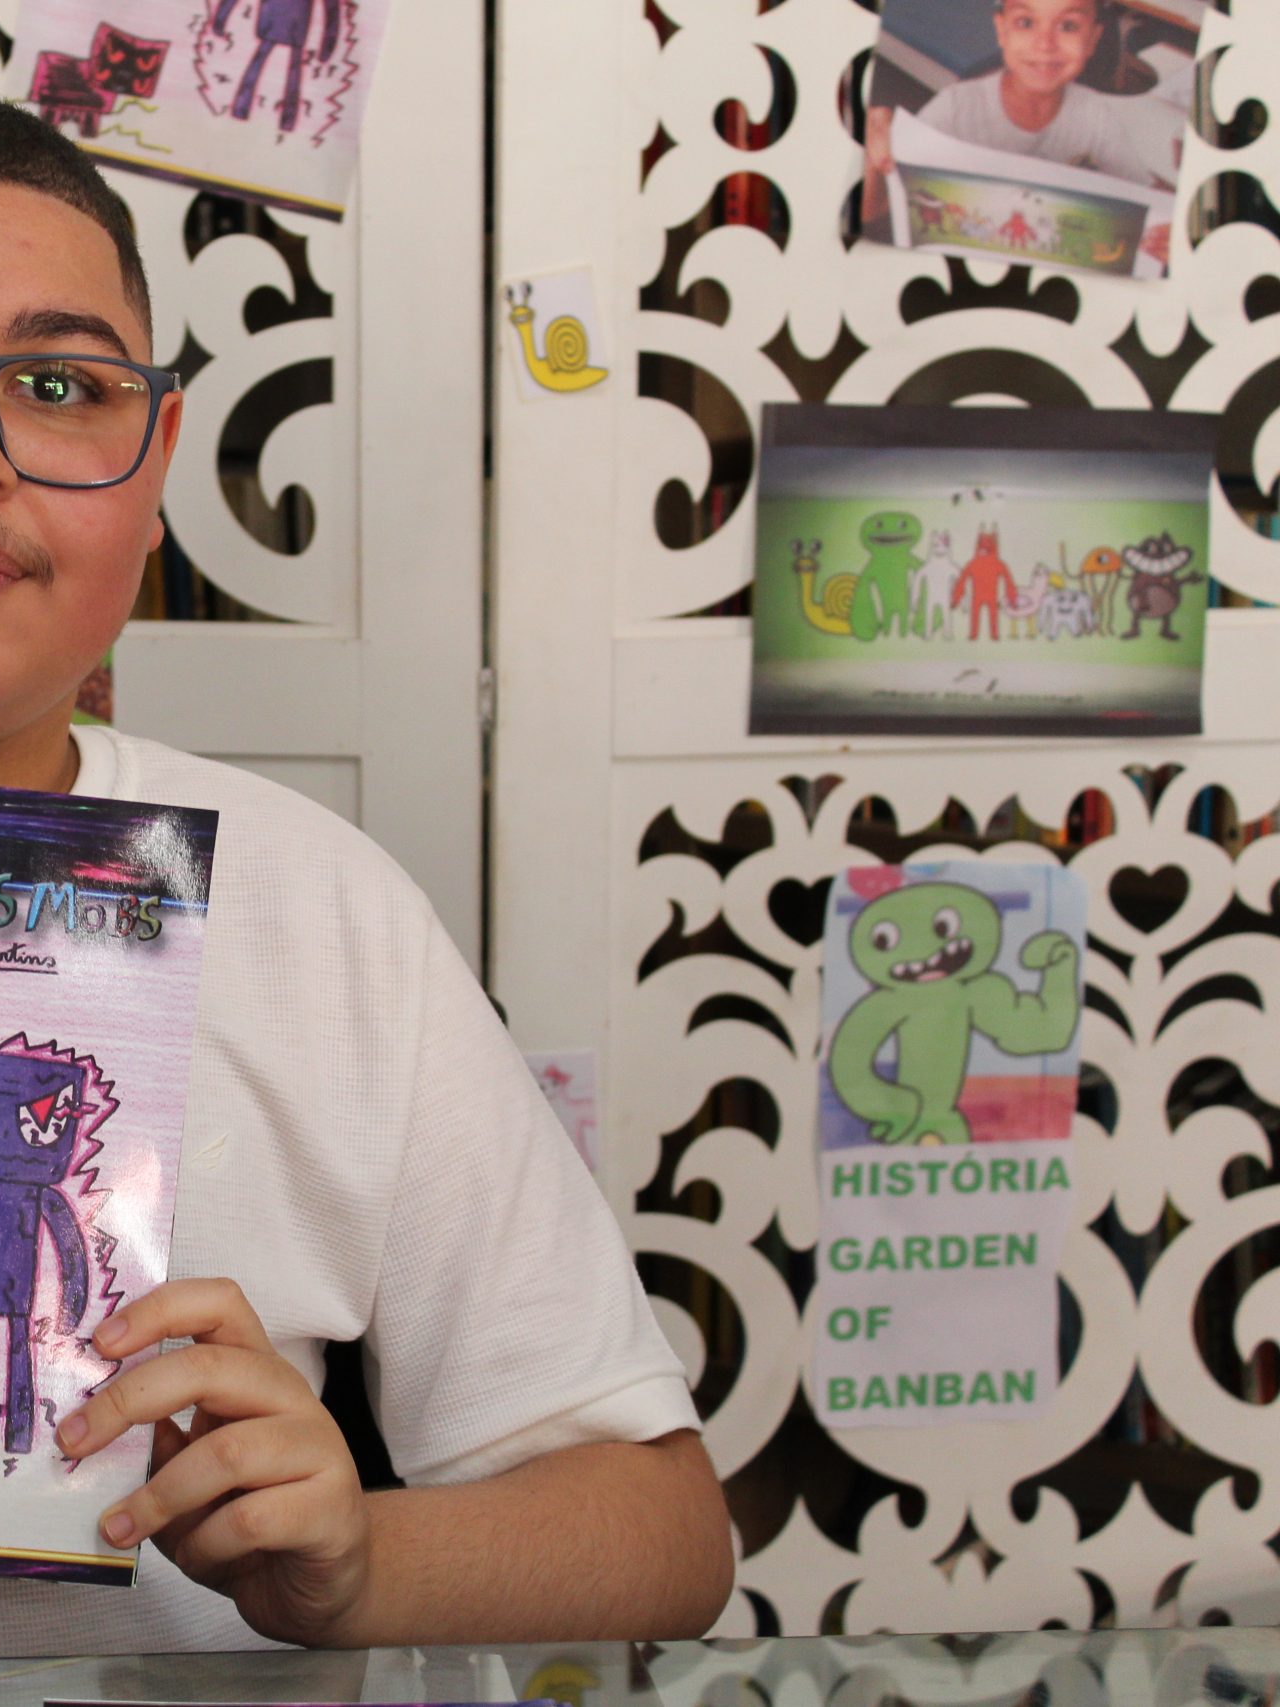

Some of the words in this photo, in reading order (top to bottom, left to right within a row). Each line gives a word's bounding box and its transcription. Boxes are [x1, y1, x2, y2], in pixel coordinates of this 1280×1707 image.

[831, 1152, 1070, 1197] HISTÓRIA
[828, 1233, 1038, 1273] GARDEN
[827, 1306, 892, 1342] OF
[827, 1370, 1036, 1412] BANBAN
